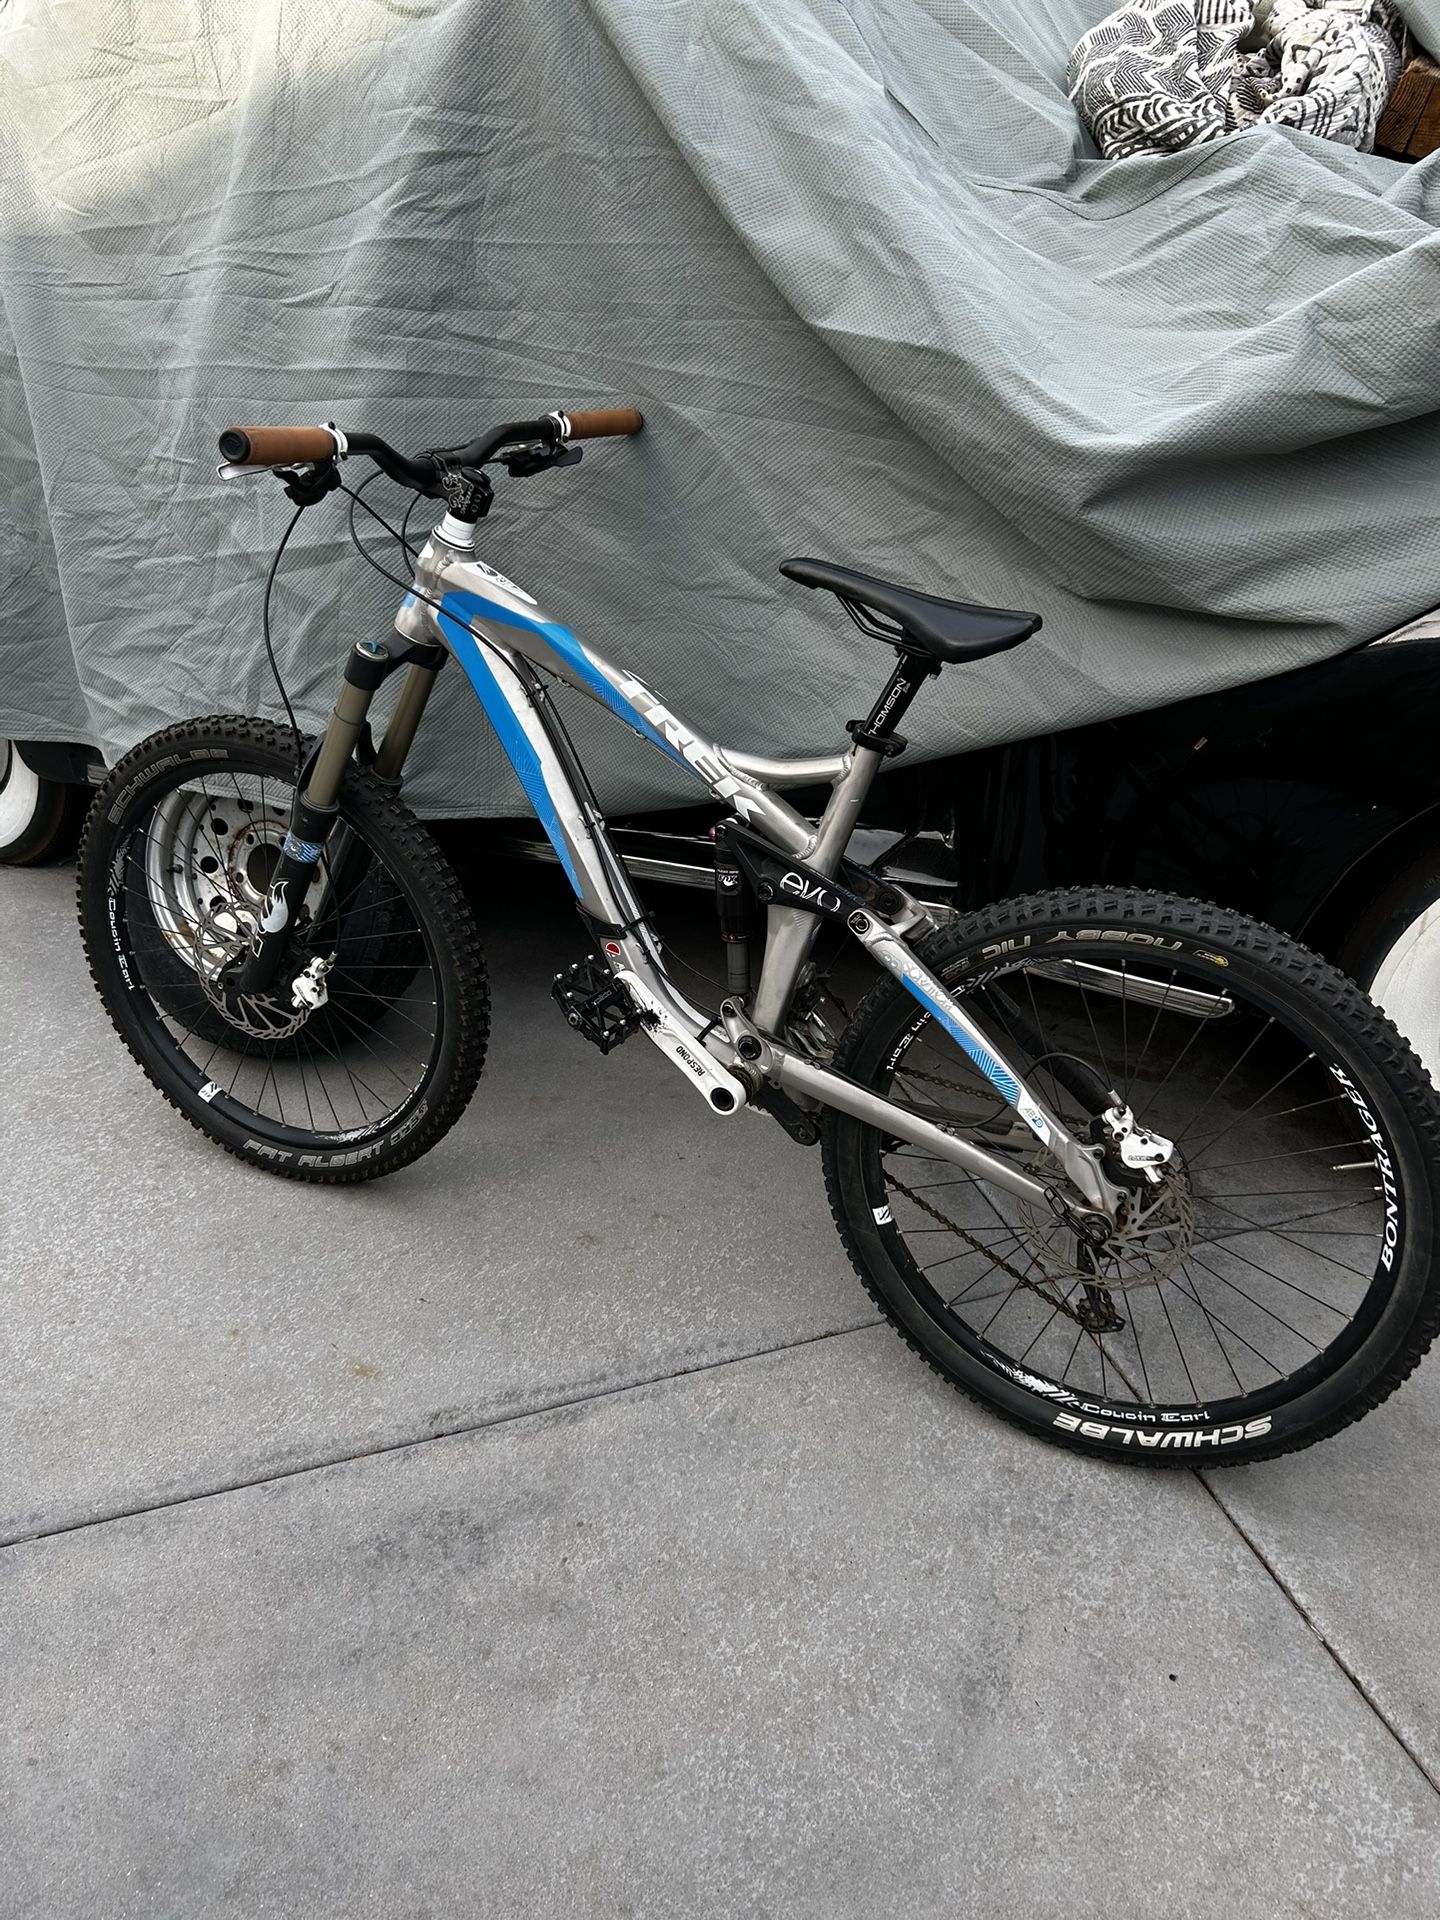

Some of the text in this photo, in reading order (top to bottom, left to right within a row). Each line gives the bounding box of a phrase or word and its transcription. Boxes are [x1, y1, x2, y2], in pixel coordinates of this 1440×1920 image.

[867, 677, 907, 735] HOMSON
[619, 669, 766, 822] TREK
[982, 929, 1183, 961] NOBBY NIC
[675, 1045, 706, 1077] RESPOND
[242, 1138, 293, 1164] FAT
[1328, 1063, 1399, 1273] BONTRAGER
[1053, 1411, 1273, 1449] SCHWALBE
